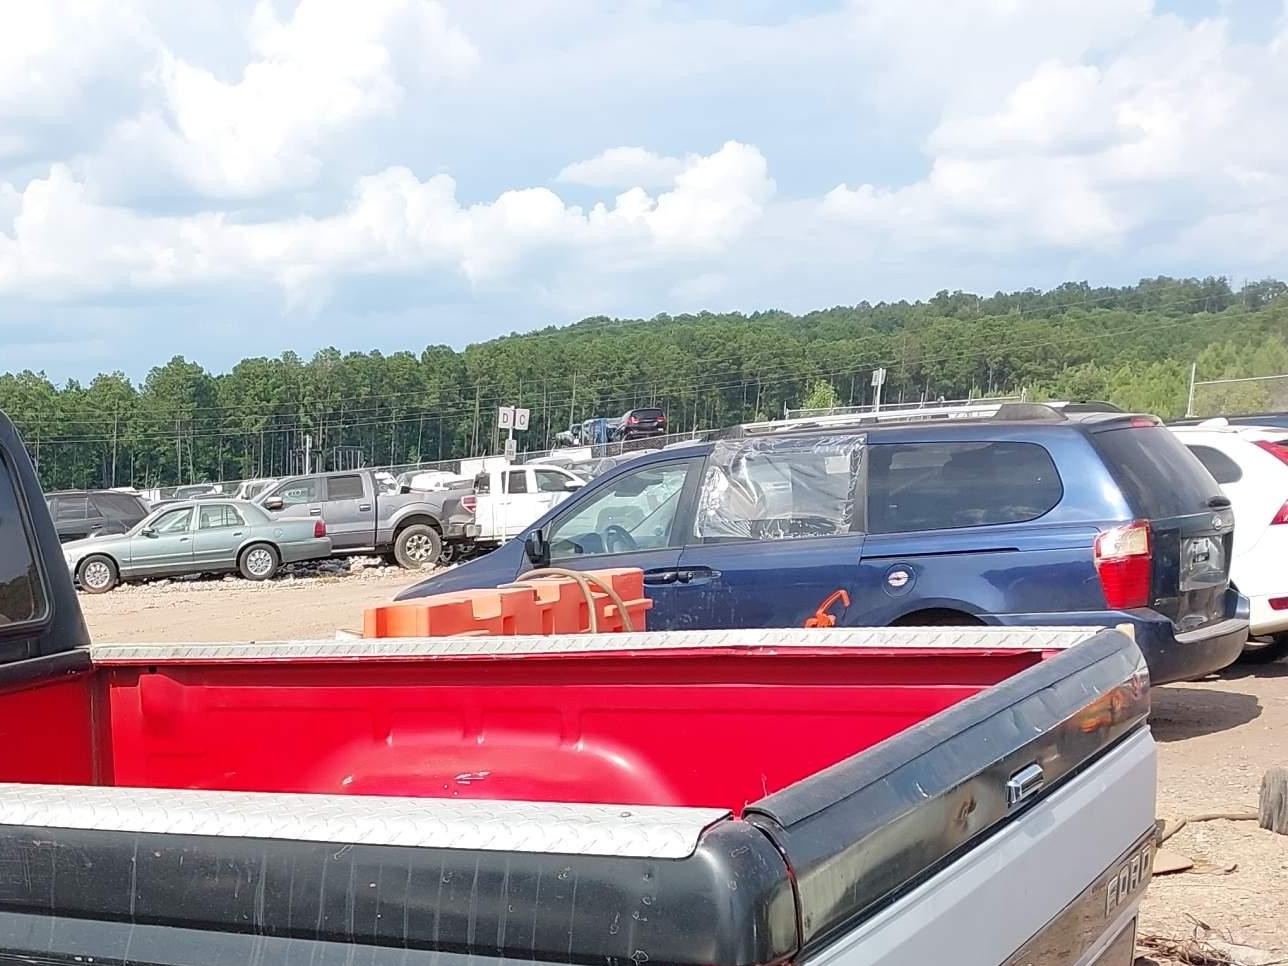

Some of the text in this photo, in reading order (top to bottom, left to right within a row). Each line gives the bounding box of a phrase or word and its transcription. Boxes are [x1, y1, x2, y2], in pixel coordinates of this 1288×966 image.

[502, 412, 509, 423] D
[519, 414, 525, 425] C
[1106, 843, 1152, 916] FORD
